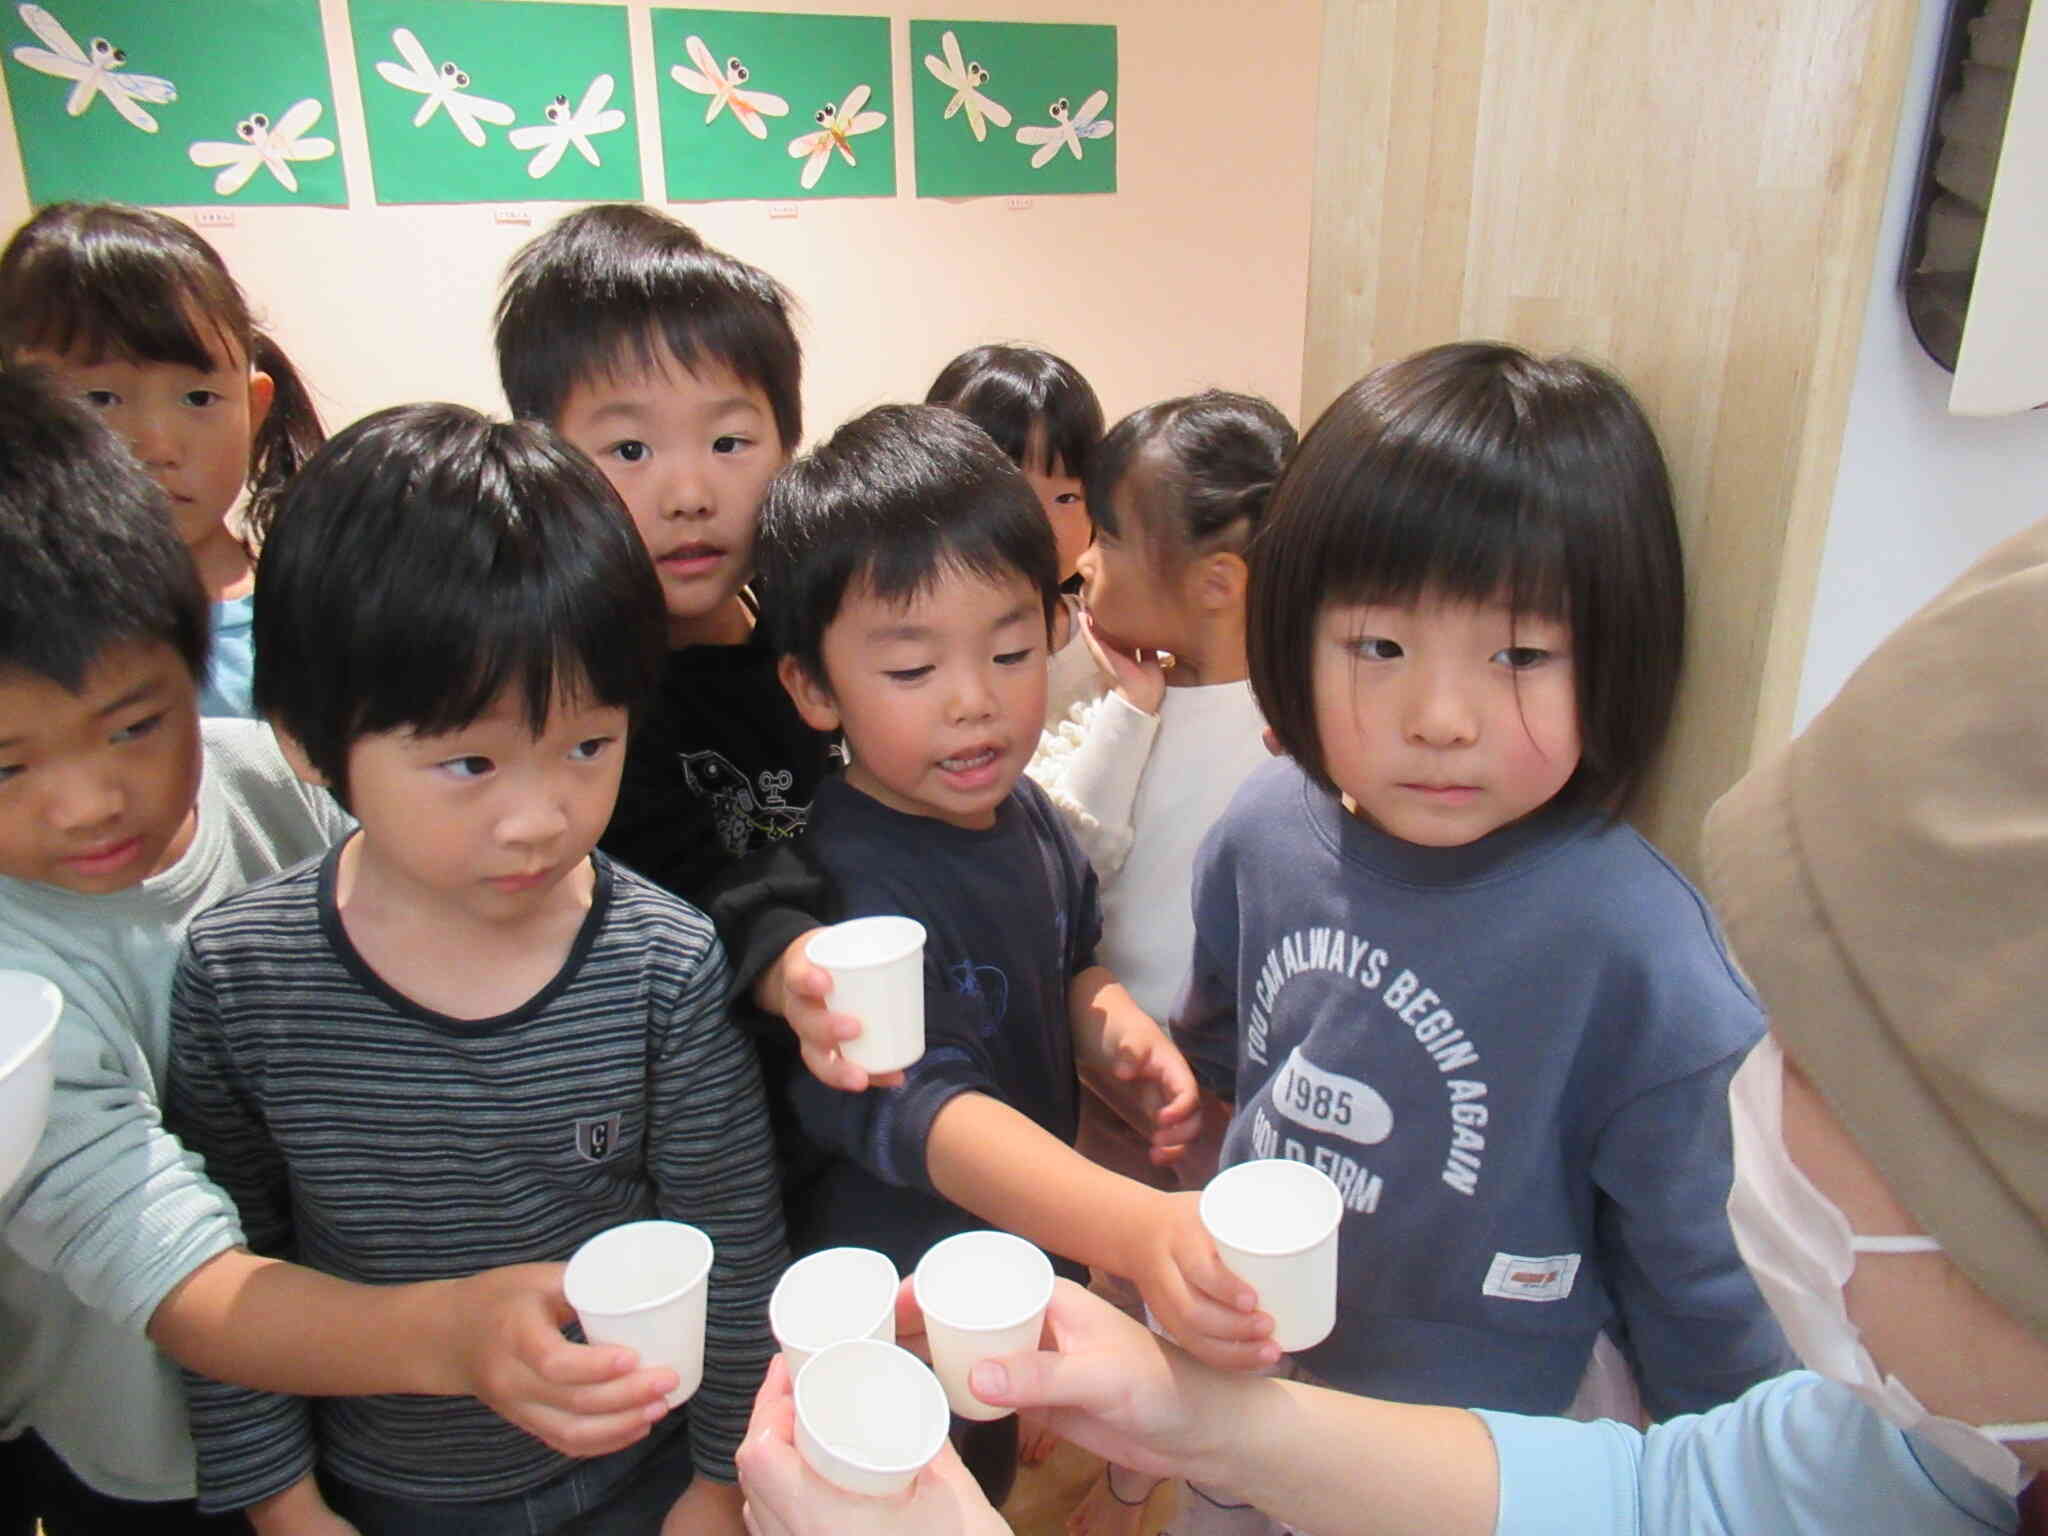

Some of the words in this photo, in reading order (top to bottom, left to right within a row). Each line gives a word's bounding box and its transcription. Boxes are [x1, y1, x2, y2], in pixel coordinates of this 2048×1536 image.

[1257, 949, 1285, 1012] CAN
[1283, 927, 1389, 989] ALWAYS
[1248, 1004, 1268, 1067] YOU
[1383, 969, 1479, 1073] BEGIN
[1284, 1069, 1354, 1126] 1985
[1442, 1079, 1488, 1196] AGAIN
[1314, 1146, 1384, 1214] FIRM
